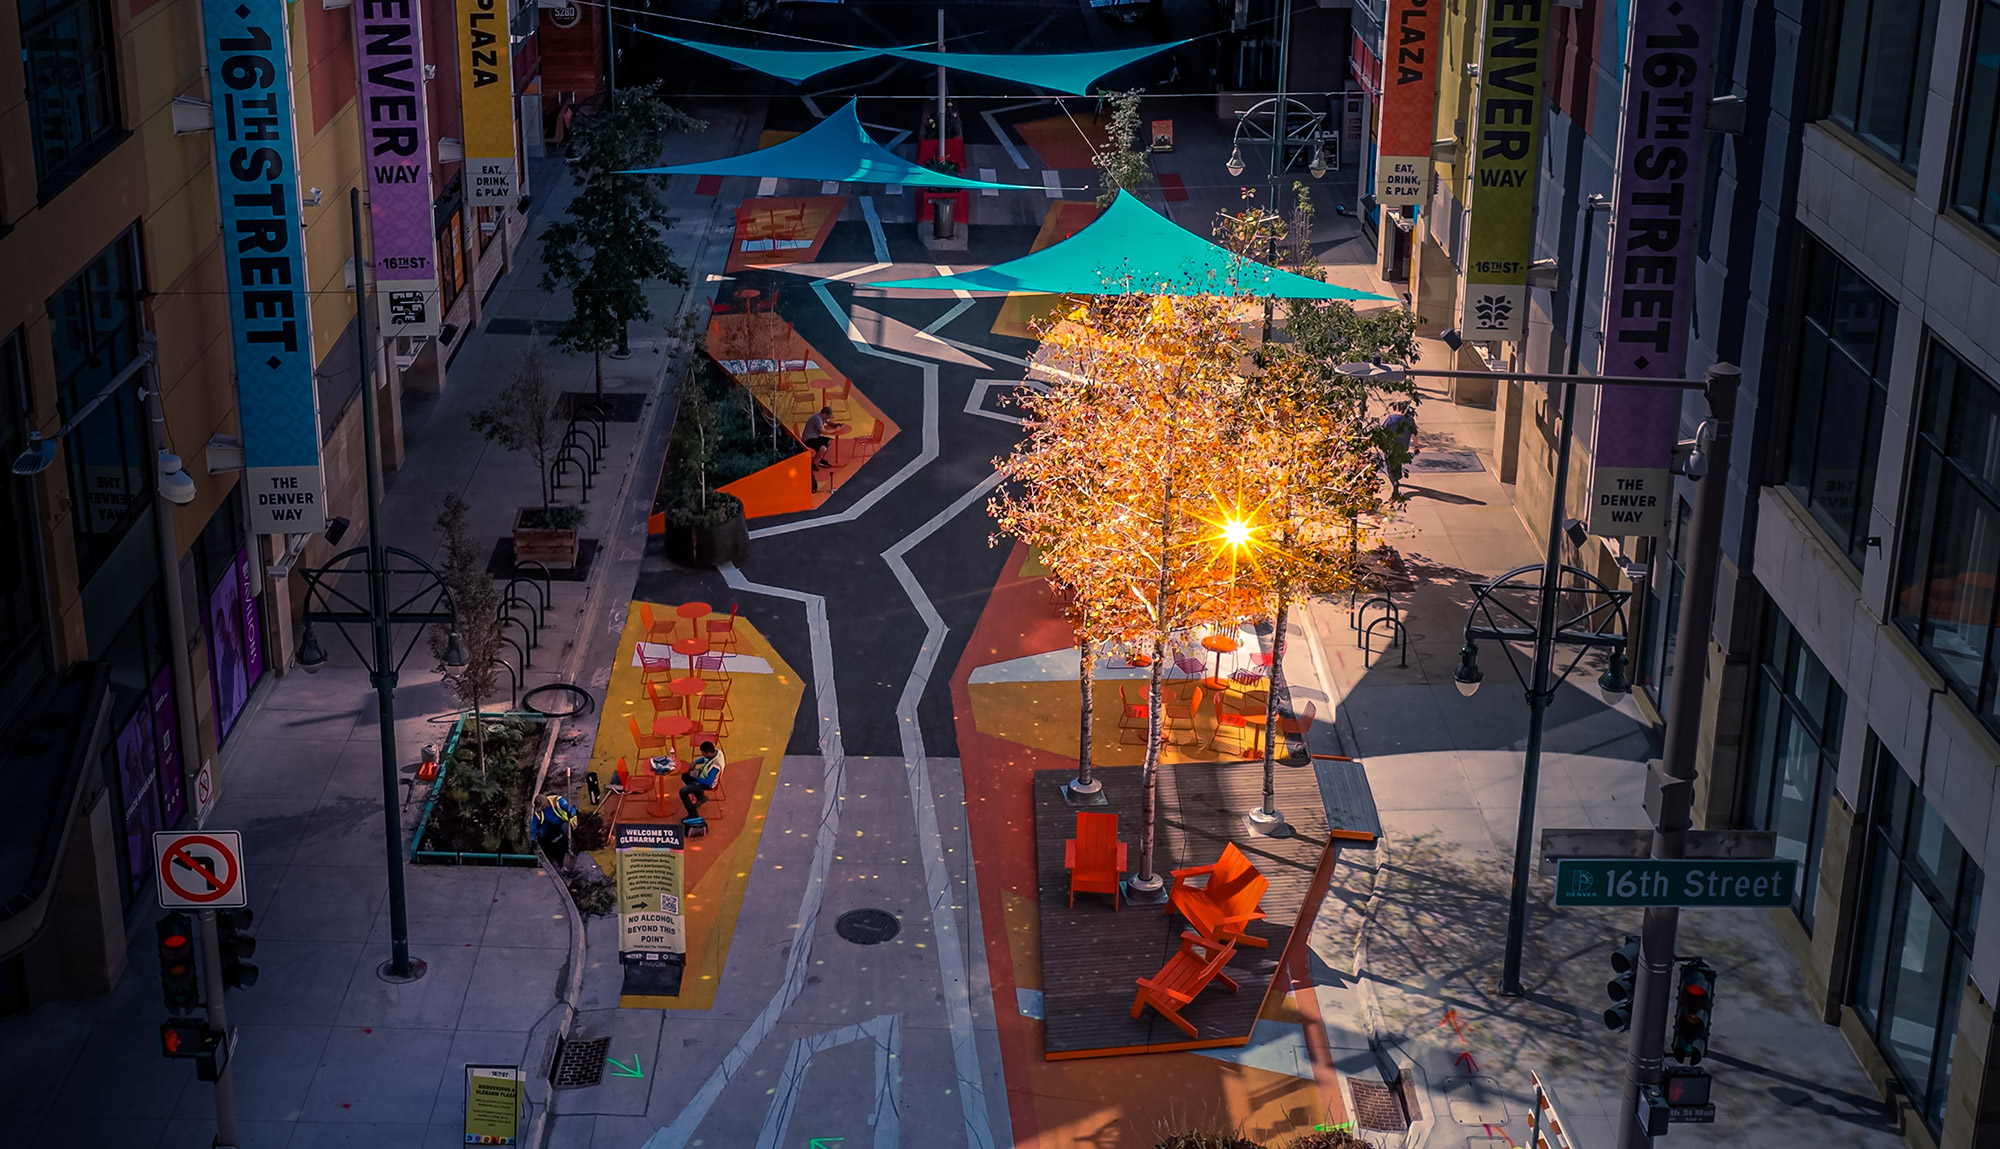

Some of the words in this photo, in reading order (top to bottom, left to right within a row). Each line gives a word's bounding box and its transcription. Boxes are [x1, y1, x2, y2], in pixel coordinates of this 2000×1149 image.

[482, 166, 502, 175] EAT,
[1394, 164, 1414, 174] EAT,
[374, 165, 420, 184] WAY
[1480, 168, 1528, 188] WAY
[476, 177, 509, 186] DRINK,
[1388, 175, 1420, 185] DRINK,
[476, 188, 482, 197] &
[485, 188, 509, 197] PLAY
[1386, 186, 1392, 195] &
[1395, 187, 1420, 195] PLAY
[271, 477, 298, 489] THE
[1617, 479, 1643, 490] THE
[259, 493, 314, 505] DENVER
[1601, 495, 1656, 507] DENVER
[272, 509, 303, 520] WAY
[1612, 511, 1643, 522] WAY
[656, 837, 680, 845] PLAZA
[1606, 869, 1669, 898] 16th
[1683, 870, 1783, 898] Street
[641, 915, 674, 924] ALCOHOL
[628, 925, 658, 934] BEYOND
[660, 926, 676, 935] THIS
